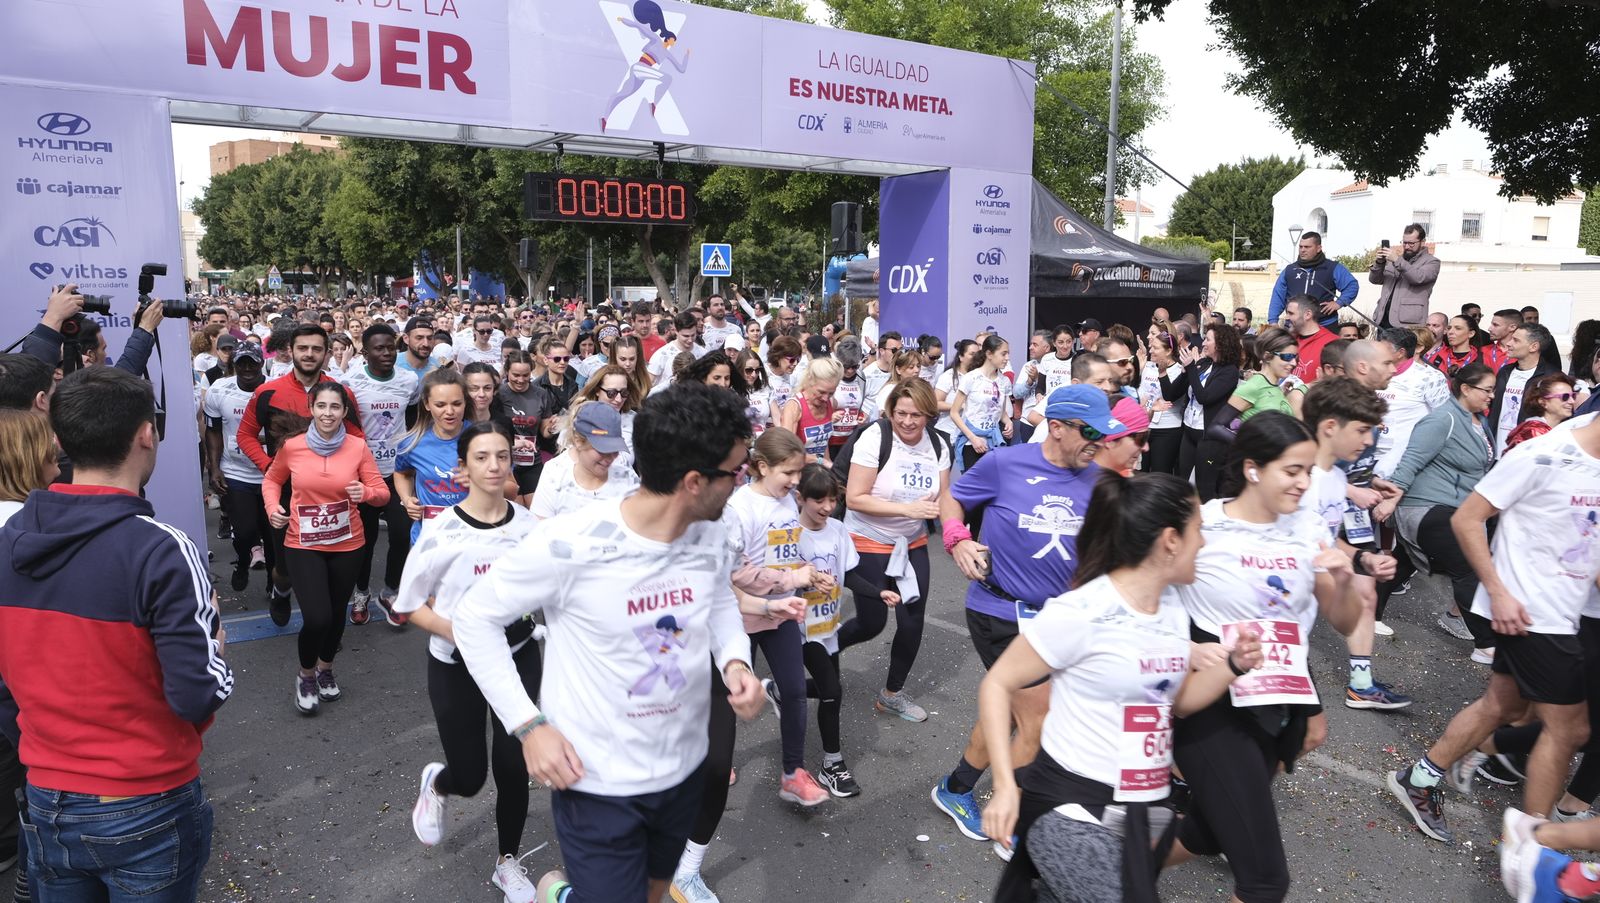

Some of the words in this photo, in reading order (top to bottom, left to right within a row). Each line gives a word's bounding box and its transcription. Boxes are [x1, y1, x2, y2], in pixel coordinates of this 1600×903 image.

[424, 0, 459, 19] LA
[182, 0, 477, 95] MUJER
[818, 50, 840, 71] LA
[845, 53, 929, 83] IGUALDAD
[789, 77, 813, 98] ES
[817, 80, 900, 110] NUESTRA
[903, 93, 953, 116] META.
[798, 113, 828, 131] CDX
[18, 137, 113, 153] HYUNDAI
[32, 151, 104, 165] Almerialva
[47, 181, 122, 197] cajamar
[975, 199, 1011, 209] HYUNDAI
[33, 225, 100, 248] CASI
[983, 225, 1012, 235] cajamar
[976, 251, 1001, 266] CASI
[60, 264, 128, 279] vithas
[888, 257, 935, 293] CDX
[984, 275, 1009, 285] vithas
[978, 305, 1008, 317] aqualia
[371, 402, 400, 410] MUJER
[371, 448, 396, 460] 349
[901, 473, 933, 489] 1319
[311, 515, 339, 528] 644
[773, 543, 799, 560] 183
[1240, 554, 1298, 570] MUJER
[627, 587, 695, 615] MUJER
[1267, 644, 1293, 666] 42
